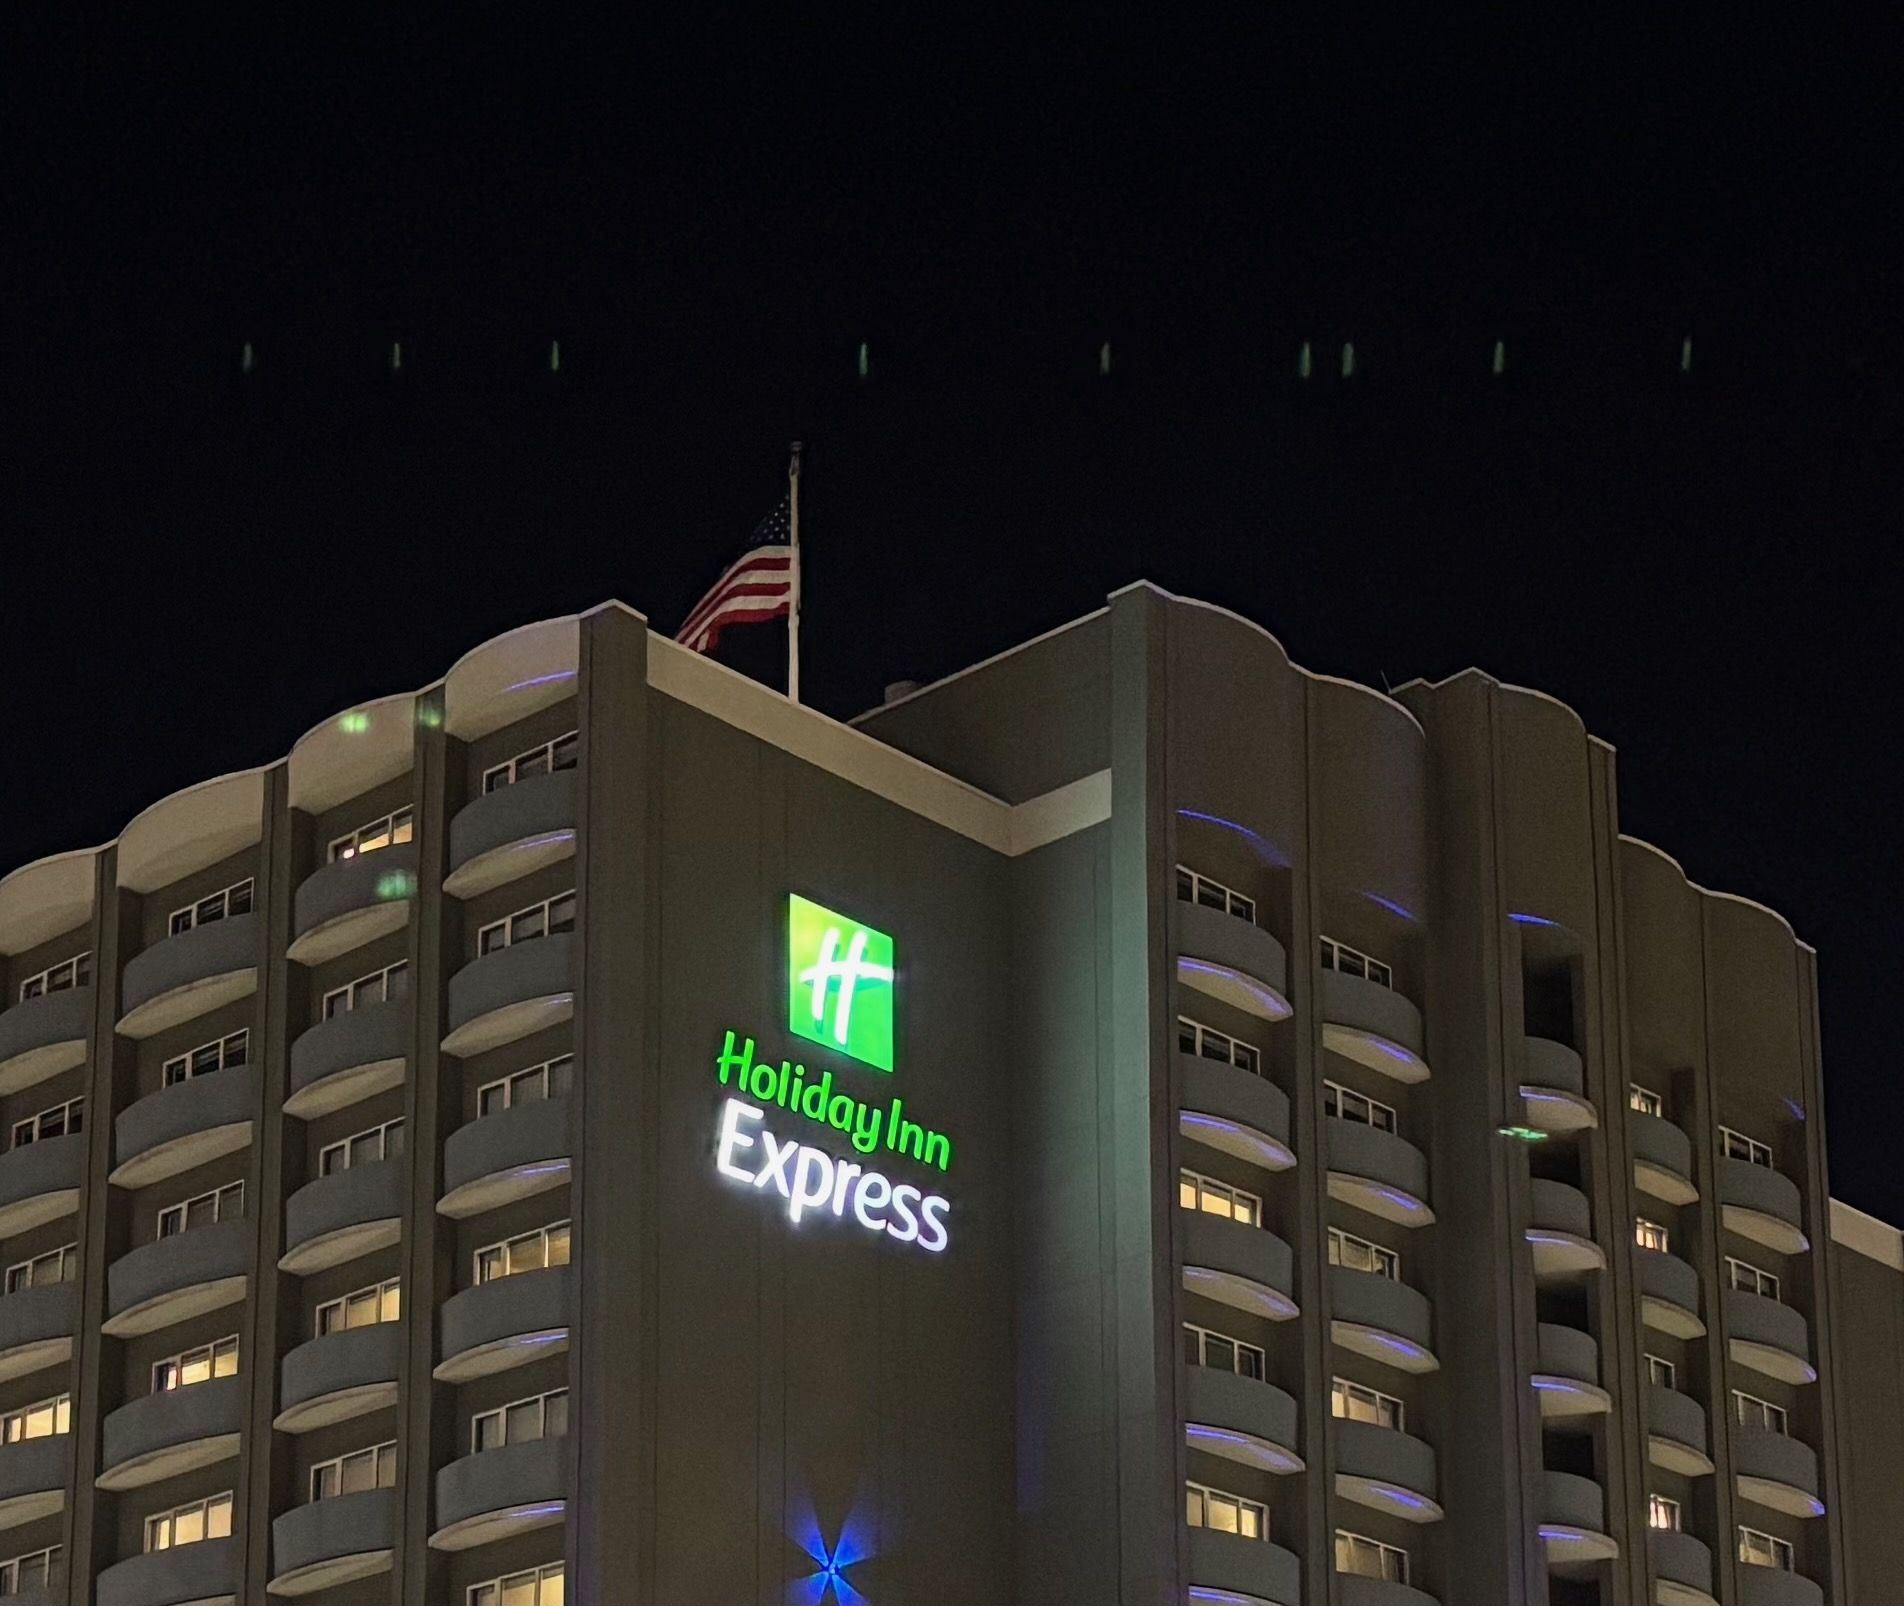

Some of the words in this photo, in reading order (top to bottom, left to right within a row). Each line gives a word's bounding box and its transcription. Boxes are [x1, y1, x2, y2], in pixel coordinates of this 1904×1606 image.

[716, 1030, 881, 1152] Holiday
[888, 1098, 950, 1171] Inn
[716, 1098, 950, 1252] Express
